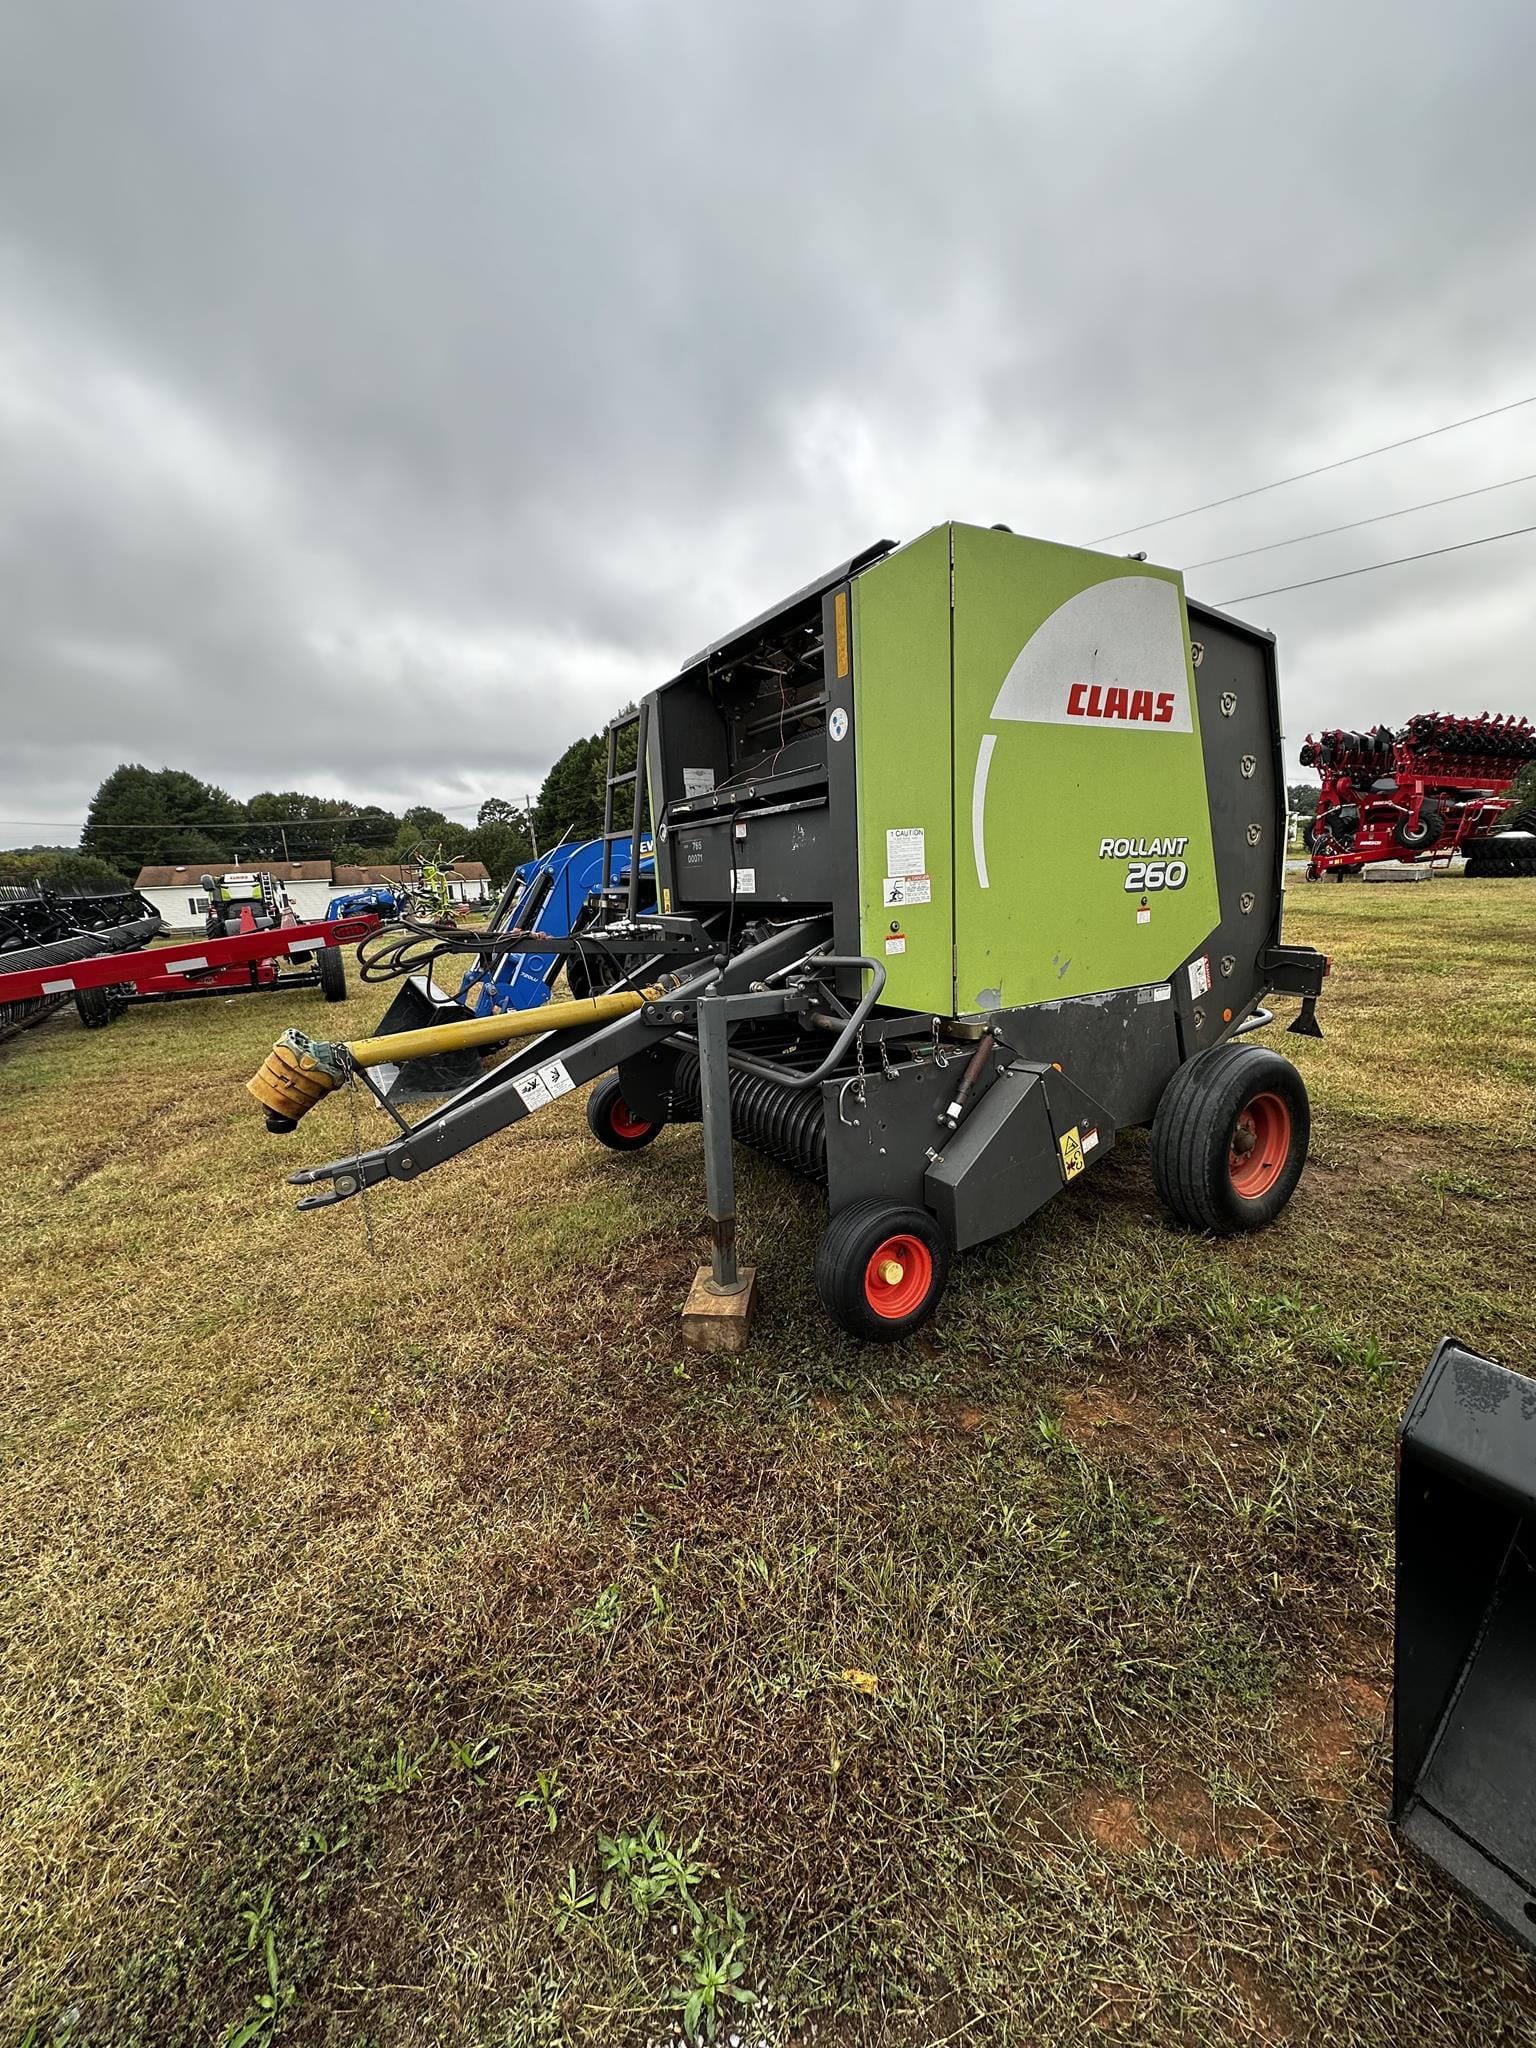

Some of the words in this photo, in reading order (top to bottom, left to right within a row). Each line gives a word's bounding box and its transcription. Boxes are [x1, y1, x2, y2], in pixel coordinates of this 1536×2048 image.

[1067, 683, 1175, 722] CLAAS
[896, 829, 924, 837] CAUTION
[1099, 837, 1189, 859] ROLLANT
[1124, 861, 1188, 892] 260
